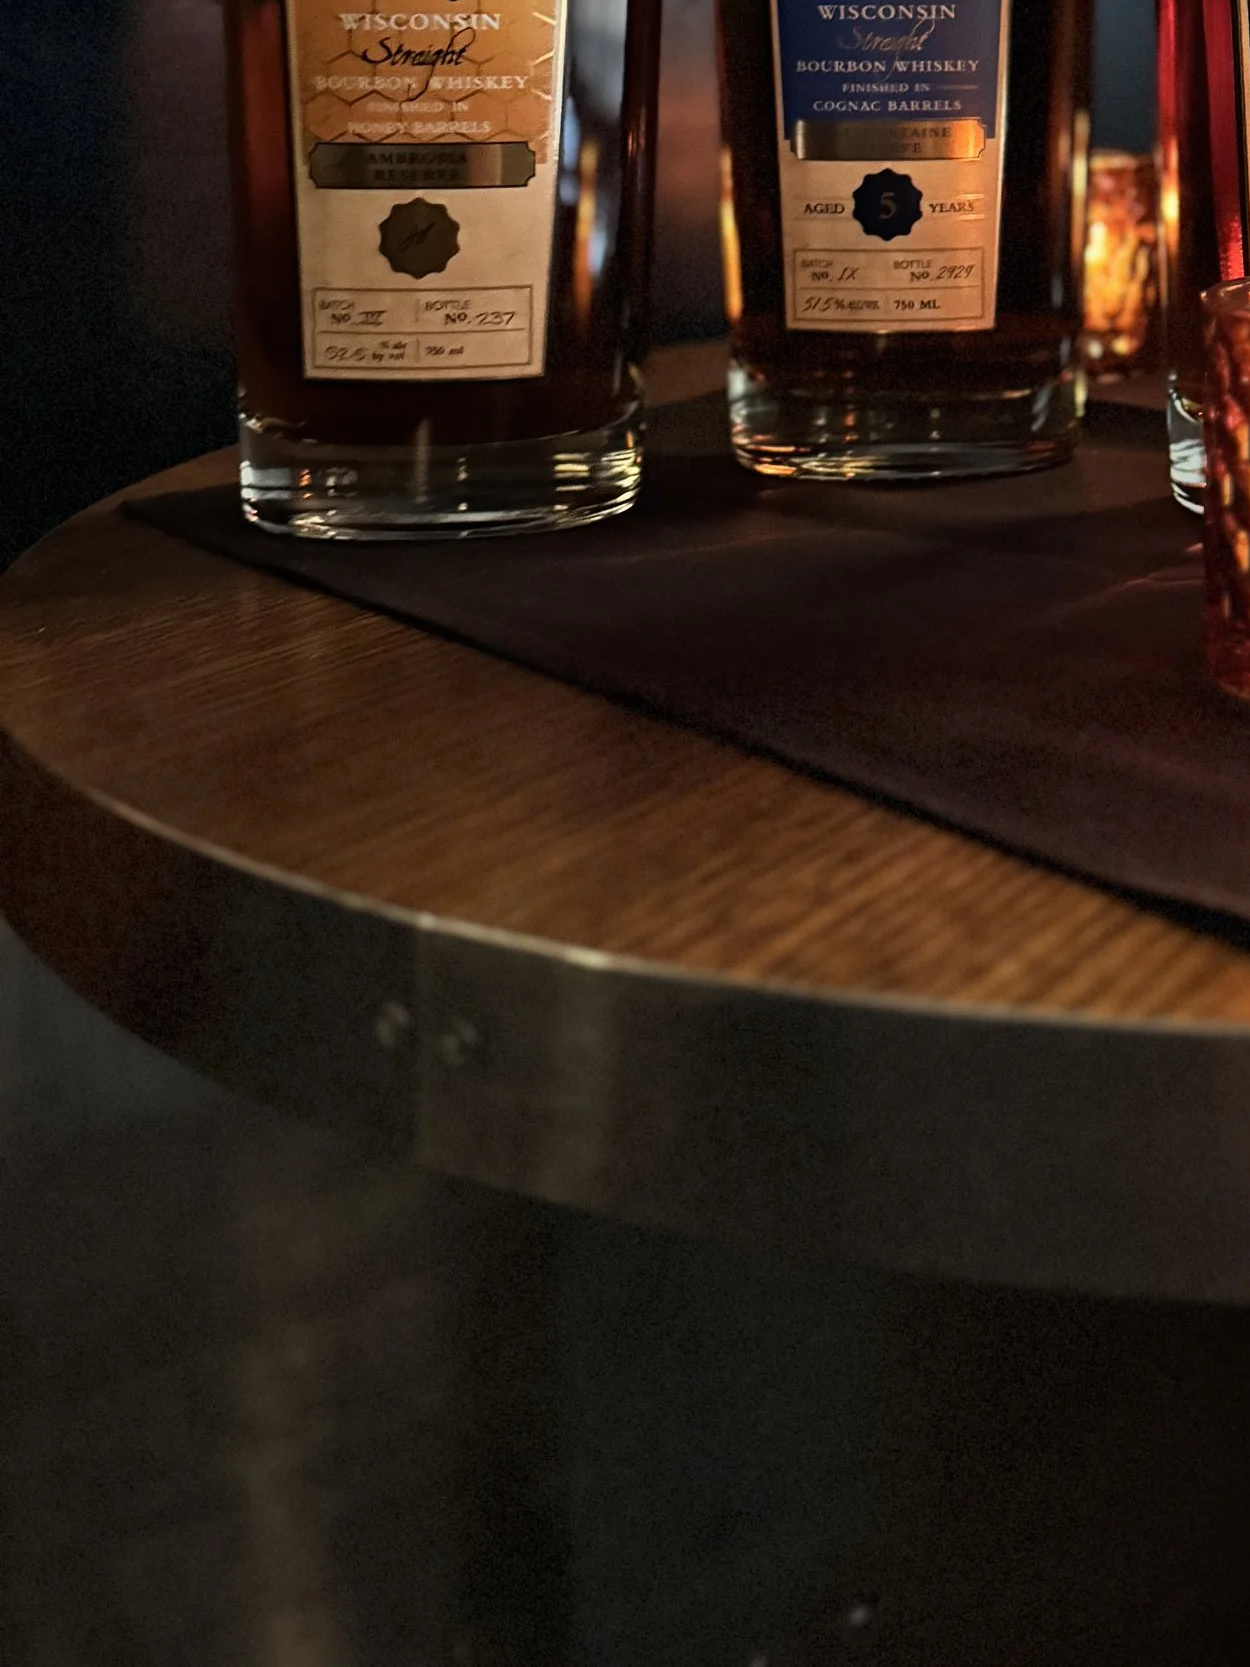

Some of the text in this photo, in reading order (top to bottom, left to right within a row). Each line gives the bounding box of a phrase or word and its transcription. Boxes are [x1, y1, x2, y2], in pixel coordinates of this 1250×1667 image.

[817, 4, 957, 21] WISCONSIN
[339, 13, 501, 31] WISCONSIN
[361, 27, 476, 102] Straight
[795, 58, 980, 74] BOURBON WHISKEY
[314, 75, 529, 90] BOURBON WHISKEY
[842, 82, 931, 93] FINISHED IN
[450, 101, 469, 112] IN
[812, 99, 963, 112] COGNAC BARRELS
[411, 120, 493, 134] BARRELS
[804, 191, 975, 221] AGED 5 YEARS
[893, 259, 933, 271] BOTTLE
[893, 299, 916, 311] 750
